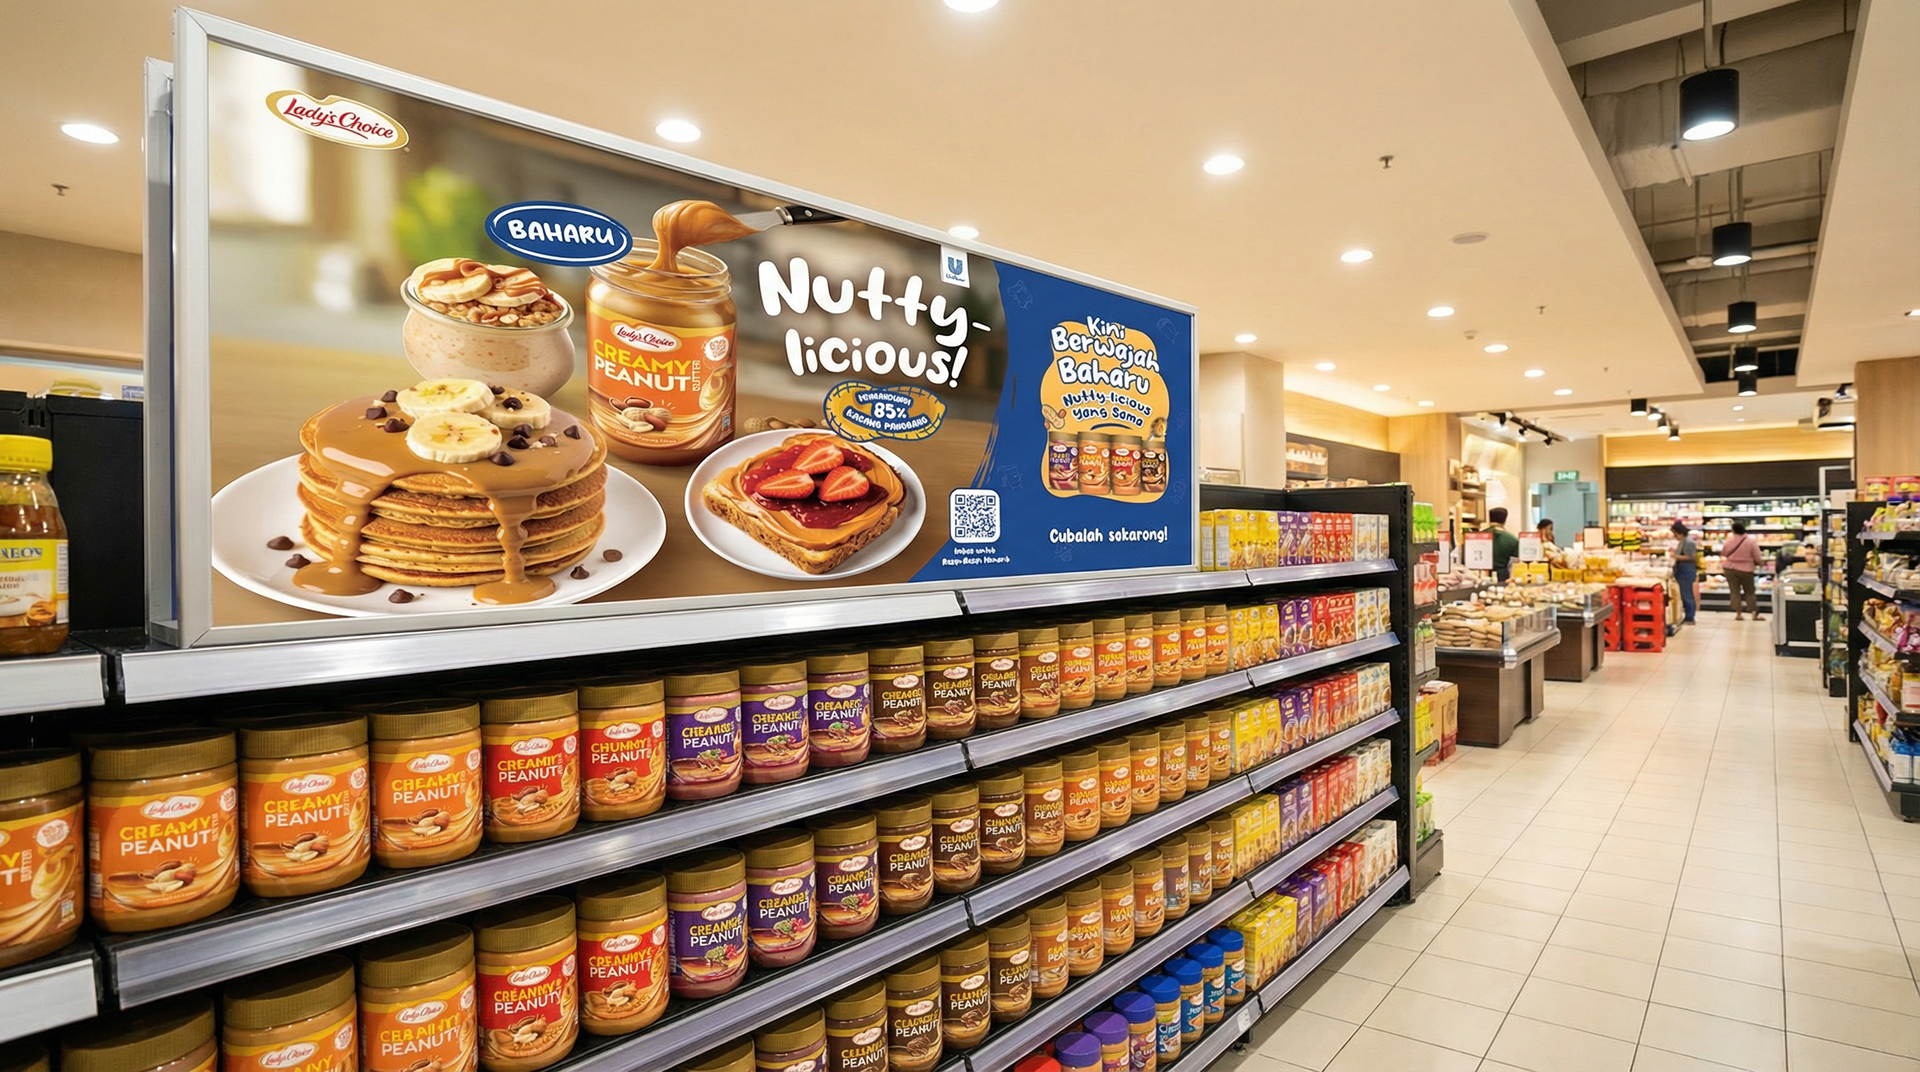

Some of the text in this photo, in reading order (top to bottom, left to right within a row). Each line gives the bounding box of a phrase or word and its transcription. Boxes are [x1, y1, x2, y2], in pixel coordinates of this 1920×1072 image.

[283, 98, 394, 140] Lady's Choice
[507, 219, 614, 247] BAHARU
[758, 257, 991, 347] Nutty-
[1087, 316, 1125, 339] Kini
[593, 338, 691, 375] CREAMY
[785, 328, 968, 389] licious!
[1051, 326, 1160, 373] Berwajah
[594, 355, 691, 391] PEANUT
[1058, 357, 1149, 394] Baharu
[874, 402, 907, 419] 85%
[1063, 390, 1152, 416] Nutty-licious
[1050, 528, 1104, 543] Cubalah
[982, 679, 1017, 689] PEANUT
[753, 720, 799, 734] PEANUT
[683, 733, 732, 749] PEANUT
[591, 748, 648, 764] PEANUT
[499, 765, 559, 783] PEANUT
[263, 792, 343, 813] CREAMY
[393, 783, 460, 804] PEANUT
[265, 804, 343, 828] PEANUT
[119, 816, 211, 841] CREAMY
[121, 829, 212, 856] PEANUT
